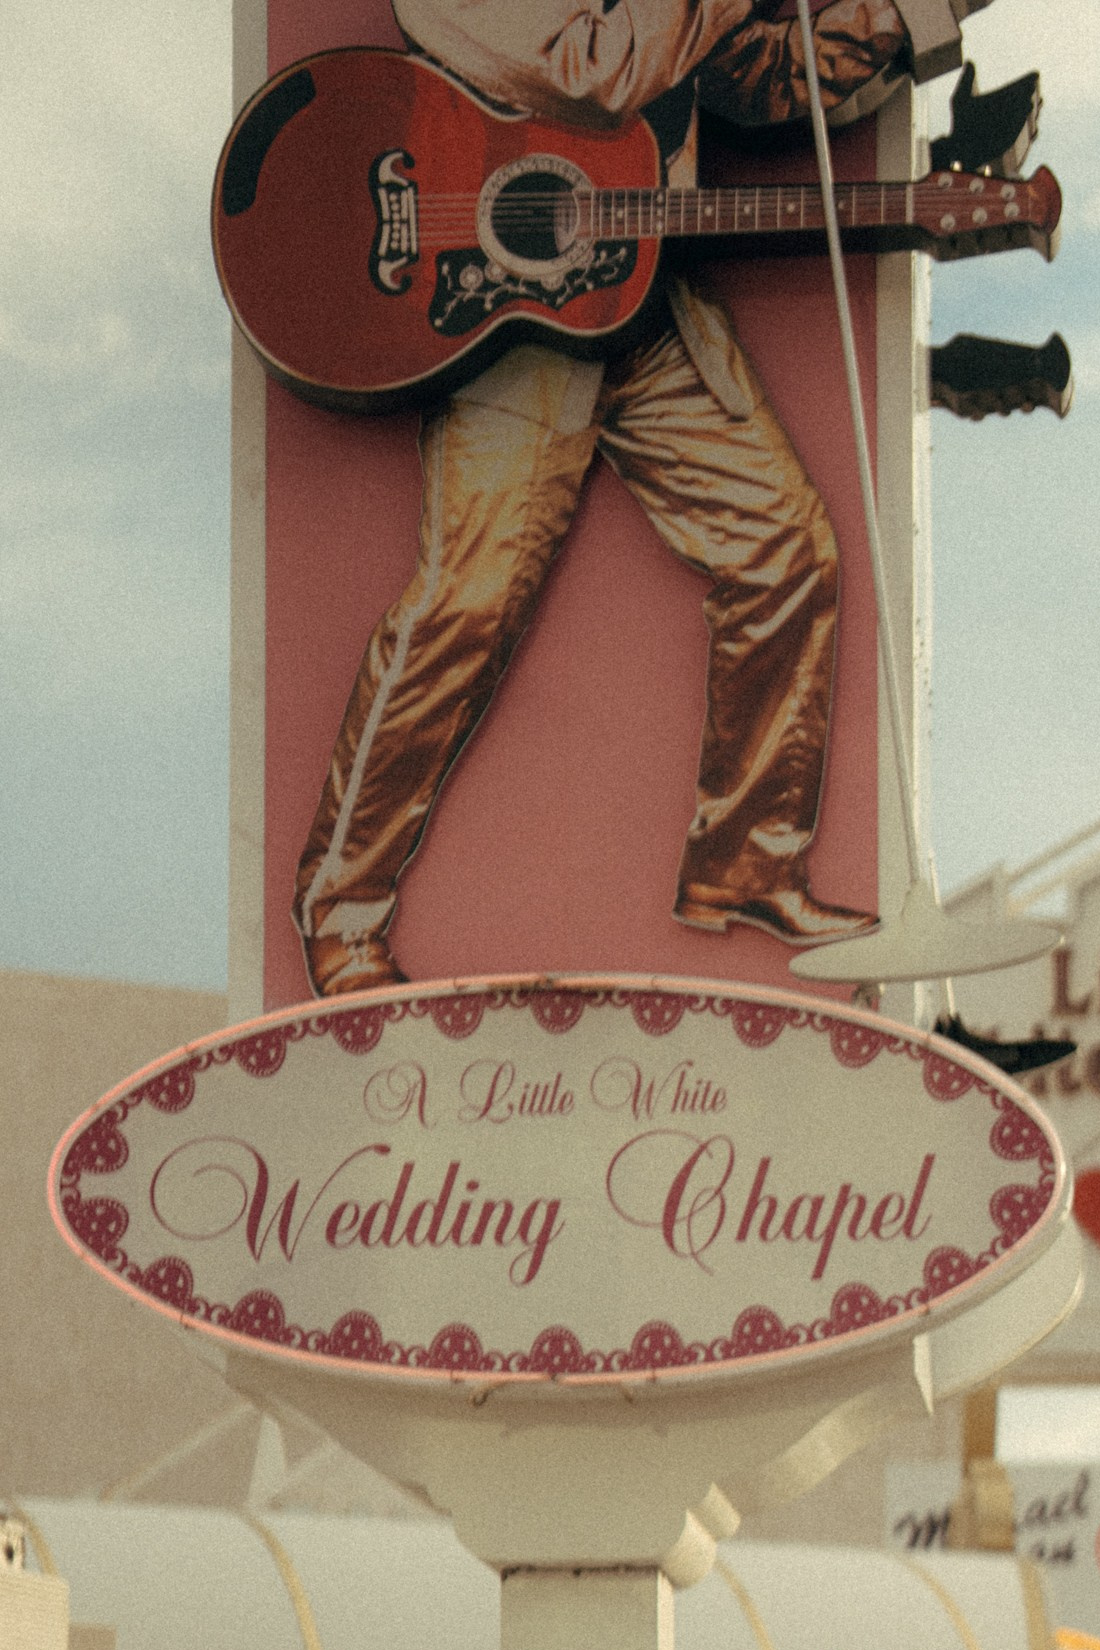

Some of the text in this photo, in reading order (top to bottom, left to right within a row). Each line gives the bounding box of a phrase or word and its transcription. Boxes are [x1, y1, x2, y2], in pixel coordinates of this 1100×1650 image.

[363, 1055, 728, 1128] A Little White
[150, 1128, 936, 1286] Wedding Chapel
